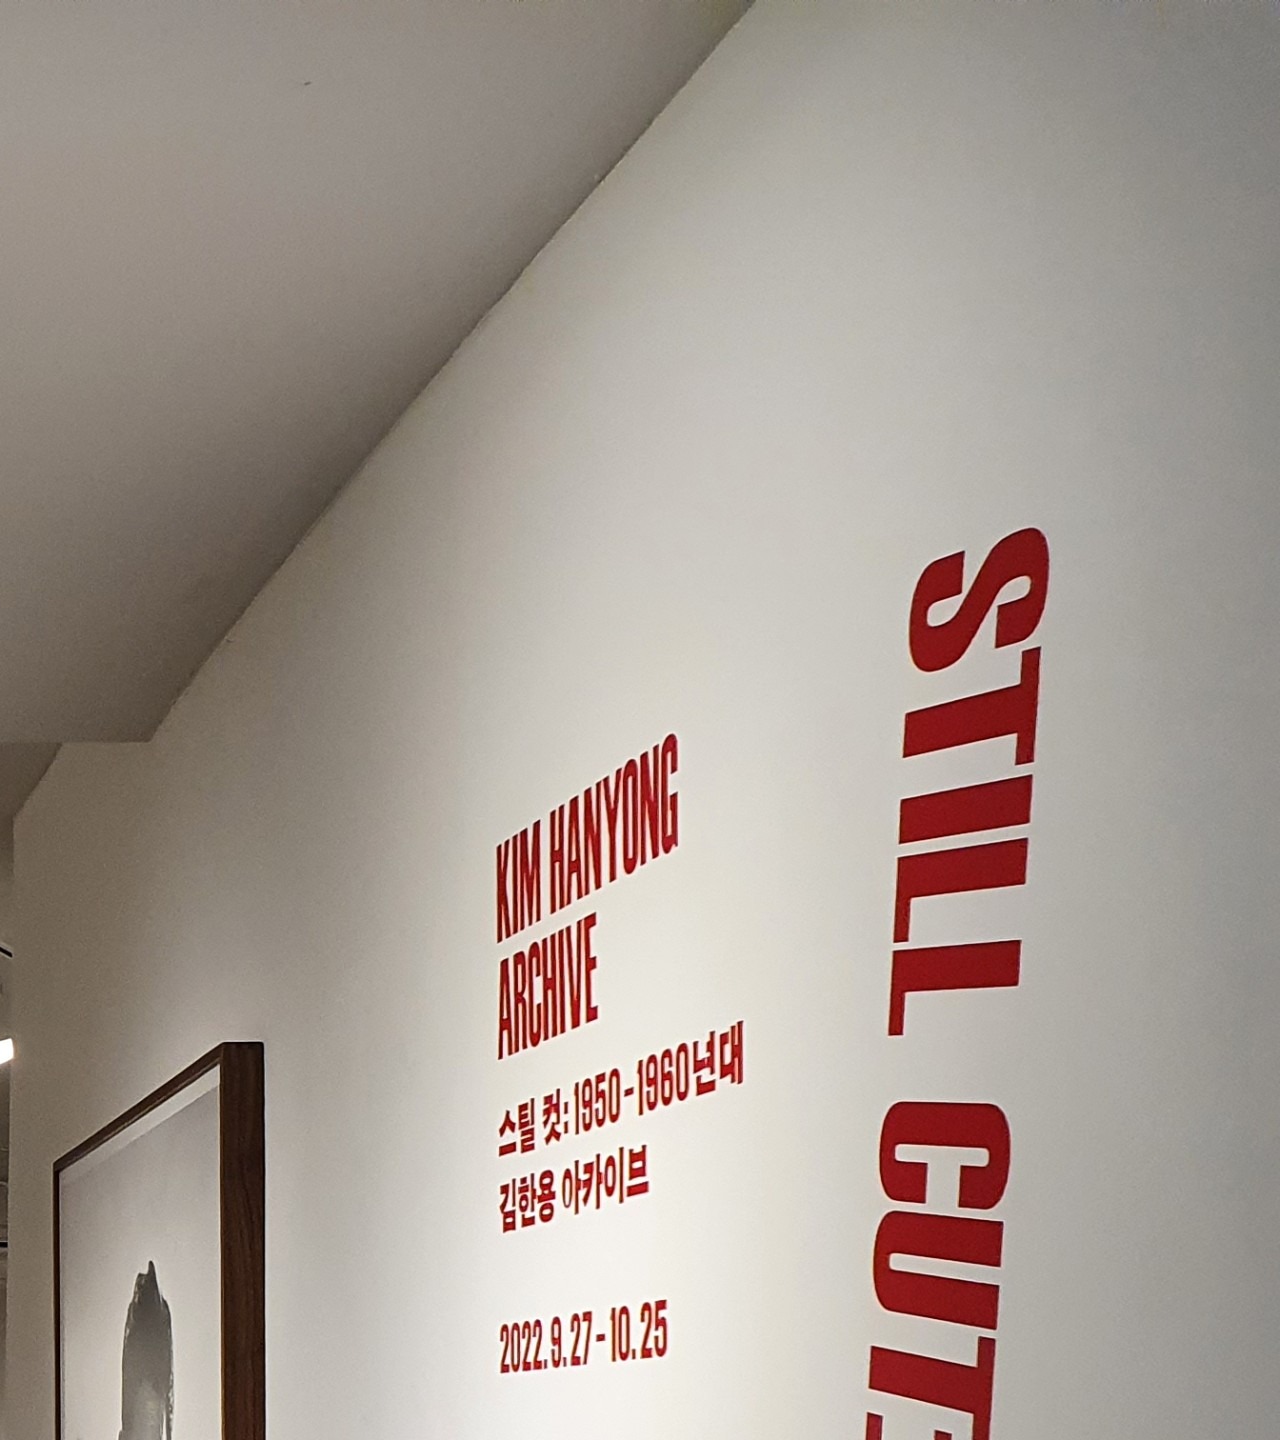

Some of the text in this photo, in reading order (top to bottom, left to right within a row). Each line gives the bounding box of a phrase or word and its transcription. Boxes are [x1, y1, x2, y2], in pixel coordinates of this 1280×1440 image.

[496, 733, 679, 943] KIM HANYONG
[887, 528, 1050, 1037] STILL
[498, 912, 599, 1060] ARCHIVE
[498, 1098, 536, 1157] 스틸
[499, 1145, 650, 1233] 김한용 아카이브
